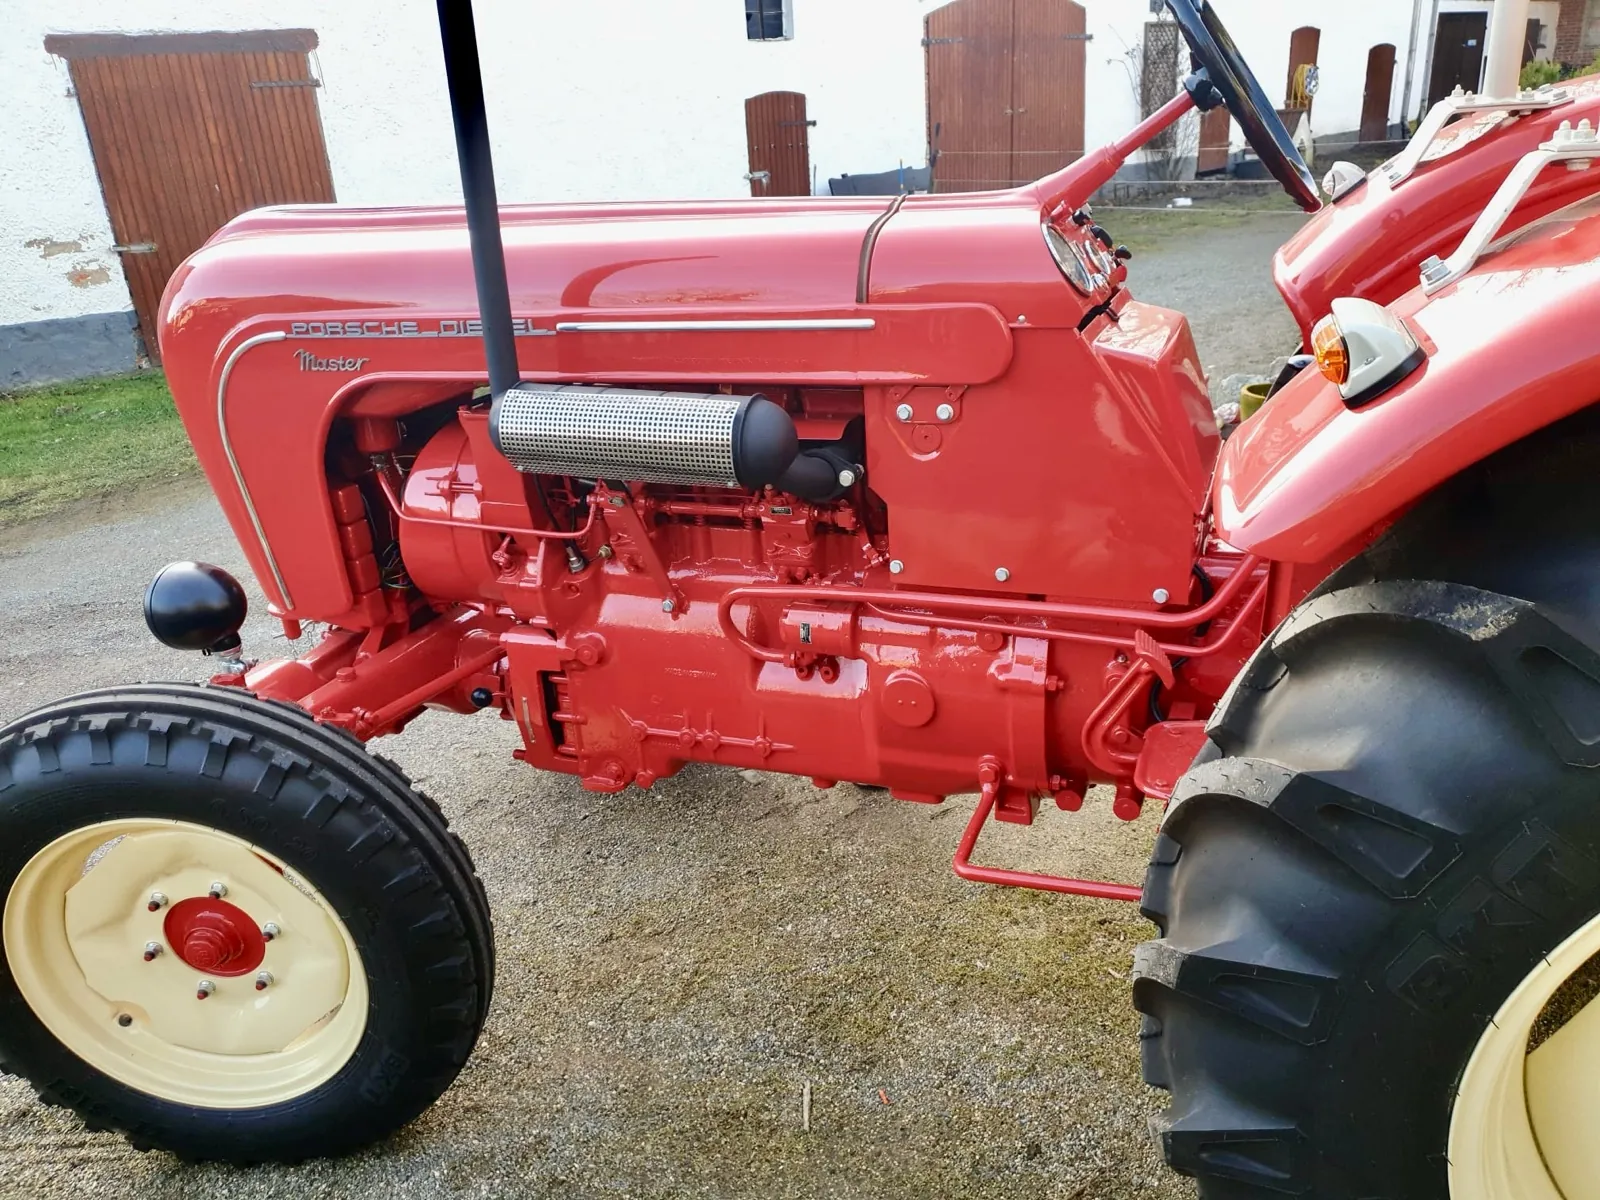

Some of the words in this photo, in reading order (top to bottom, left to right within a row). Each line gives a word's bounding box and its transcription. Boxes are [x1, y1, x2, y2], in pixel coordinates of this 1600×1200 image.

[291, 321, 420, 338] PORSCHE
[439, 319, 549, 337] DIEEL
[293, 348, 370, 372] Master
